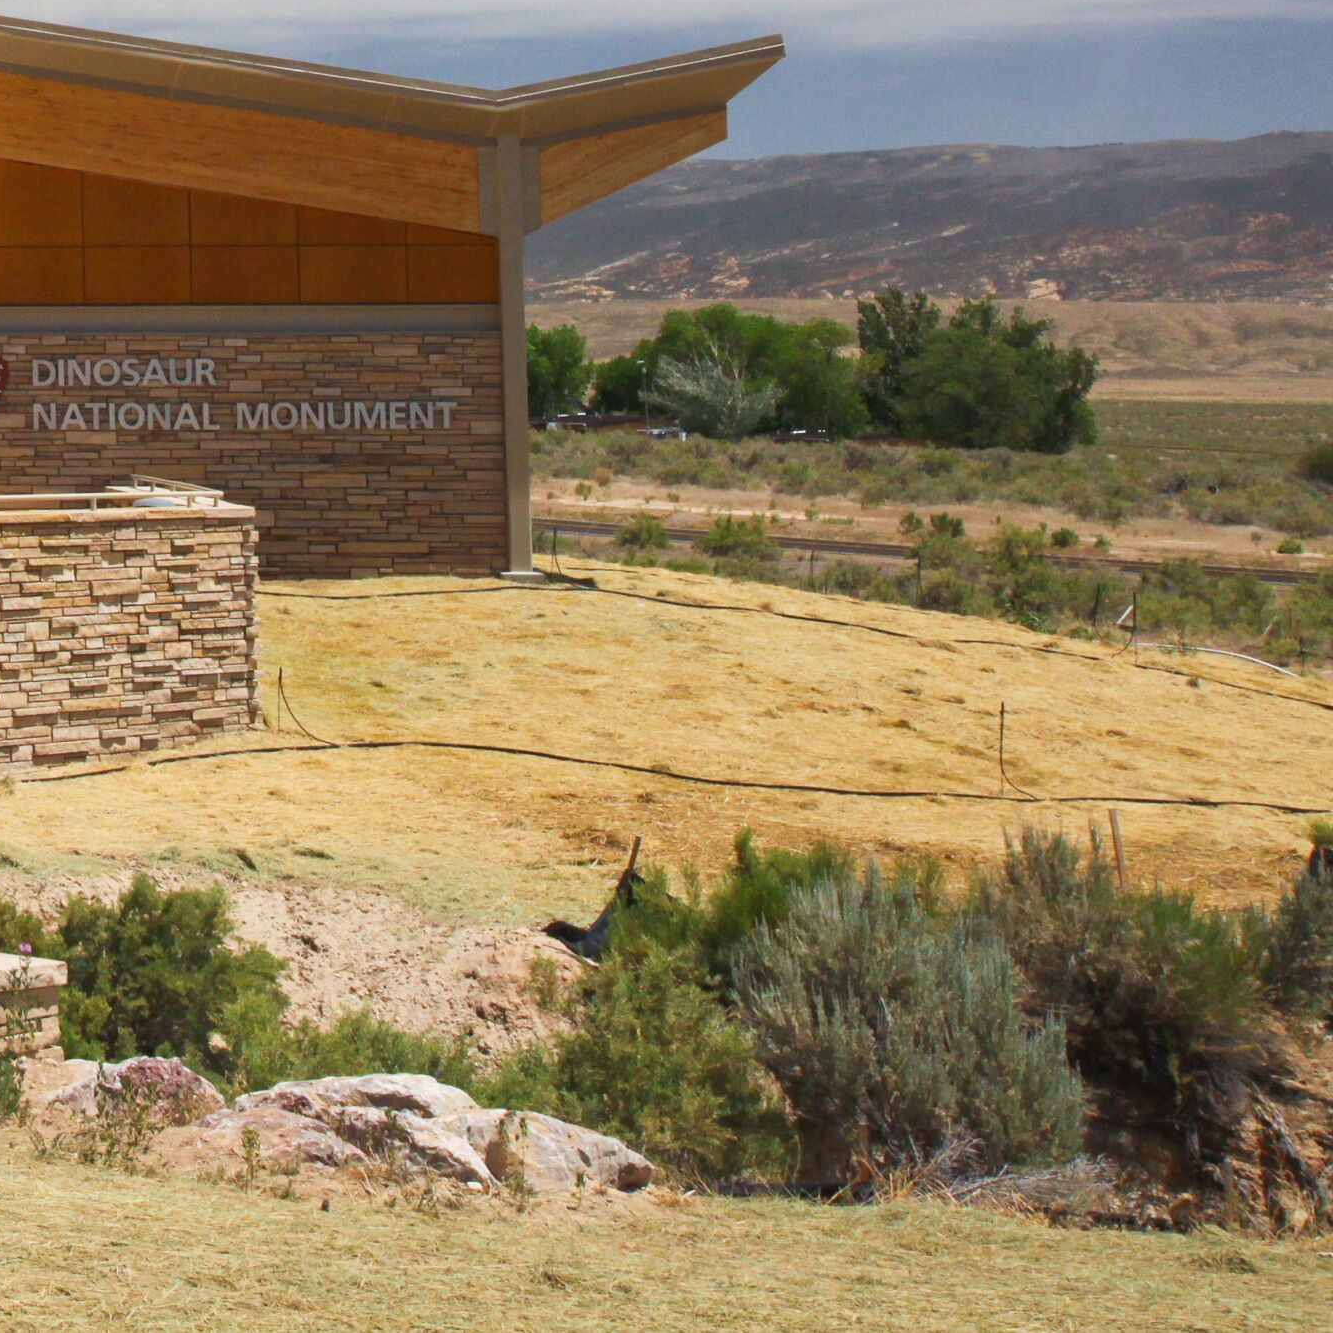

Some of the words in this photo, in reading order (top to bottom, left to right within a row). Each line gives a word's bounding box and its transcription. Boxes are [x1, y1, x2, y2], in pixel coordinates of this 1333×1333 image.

[33, 358, 217, 387] DINOSAUR
[33, 402, 220, 431] NATIONAL
[236, 401, 458, 430] MONUMENT
